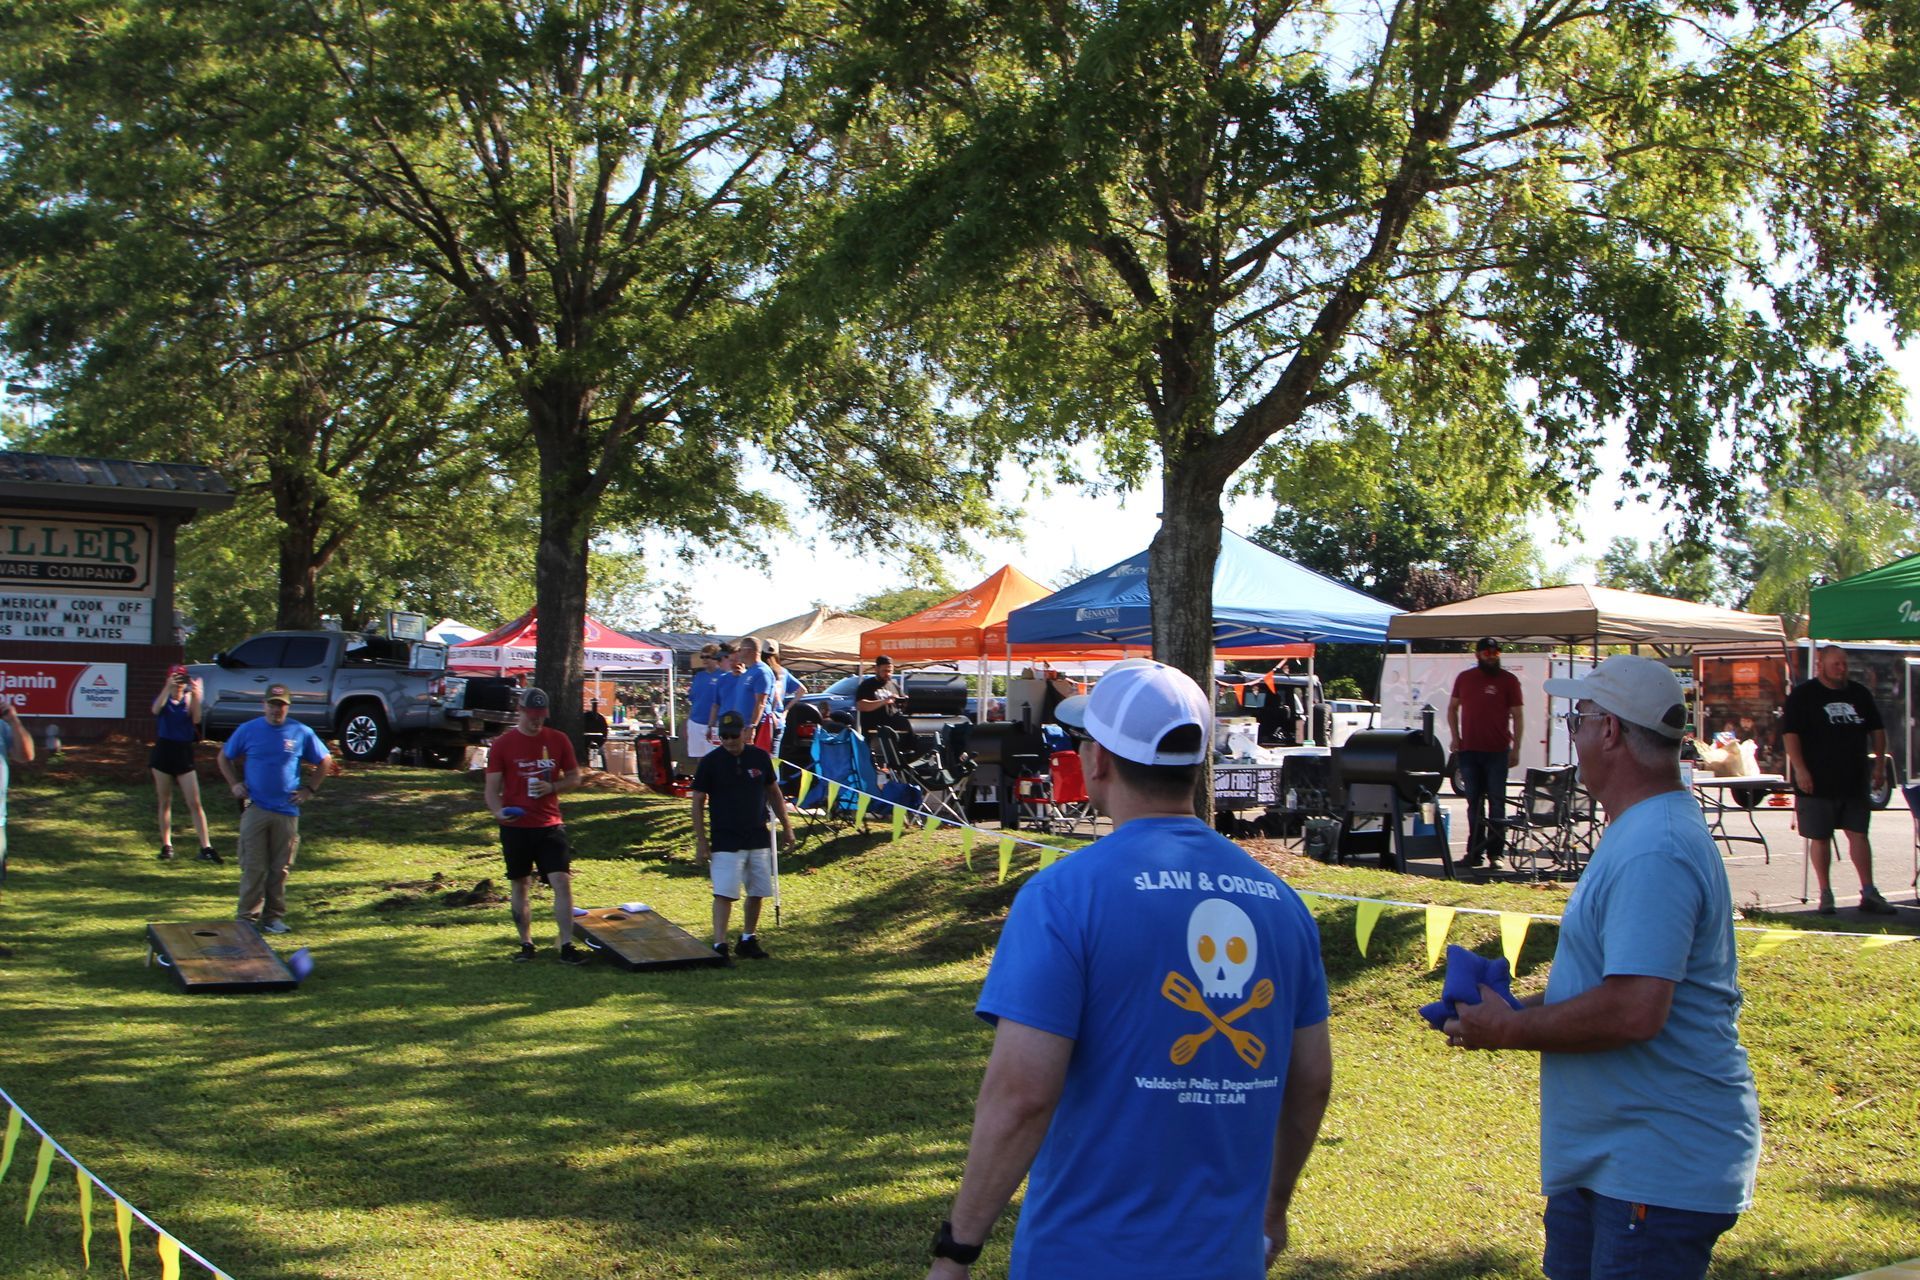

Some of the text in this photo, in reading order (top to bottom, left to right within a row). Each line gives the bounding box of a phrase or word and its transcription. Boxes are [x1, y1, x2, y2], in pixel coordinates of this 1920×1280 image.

[0, 525, 140, 565] LLER
[47, 565, 126, 579] COMPANY
[71, 600, 104, 611] COOK
[118, 602, 143, 612] OFF
[62, 612, 90, 624] MAY
[103, 615, 131, 626] 14TH
[25, 626, 65, 637] LUNCH
[77, 627, 123, 639] PLATES
[511, 652, 537, 661] LOWN
[593, 652, 611, 661] FIRE
[613, 653, 645, 662] RESCUE
[1198, 873, 1215, 891] &
[1217, 874, 1280, 900] ORDER
[1135, 1076, 1278, 1092] Valdosta Police Department
[1178, 1092, 1246, 1104] GRILL TEAM
